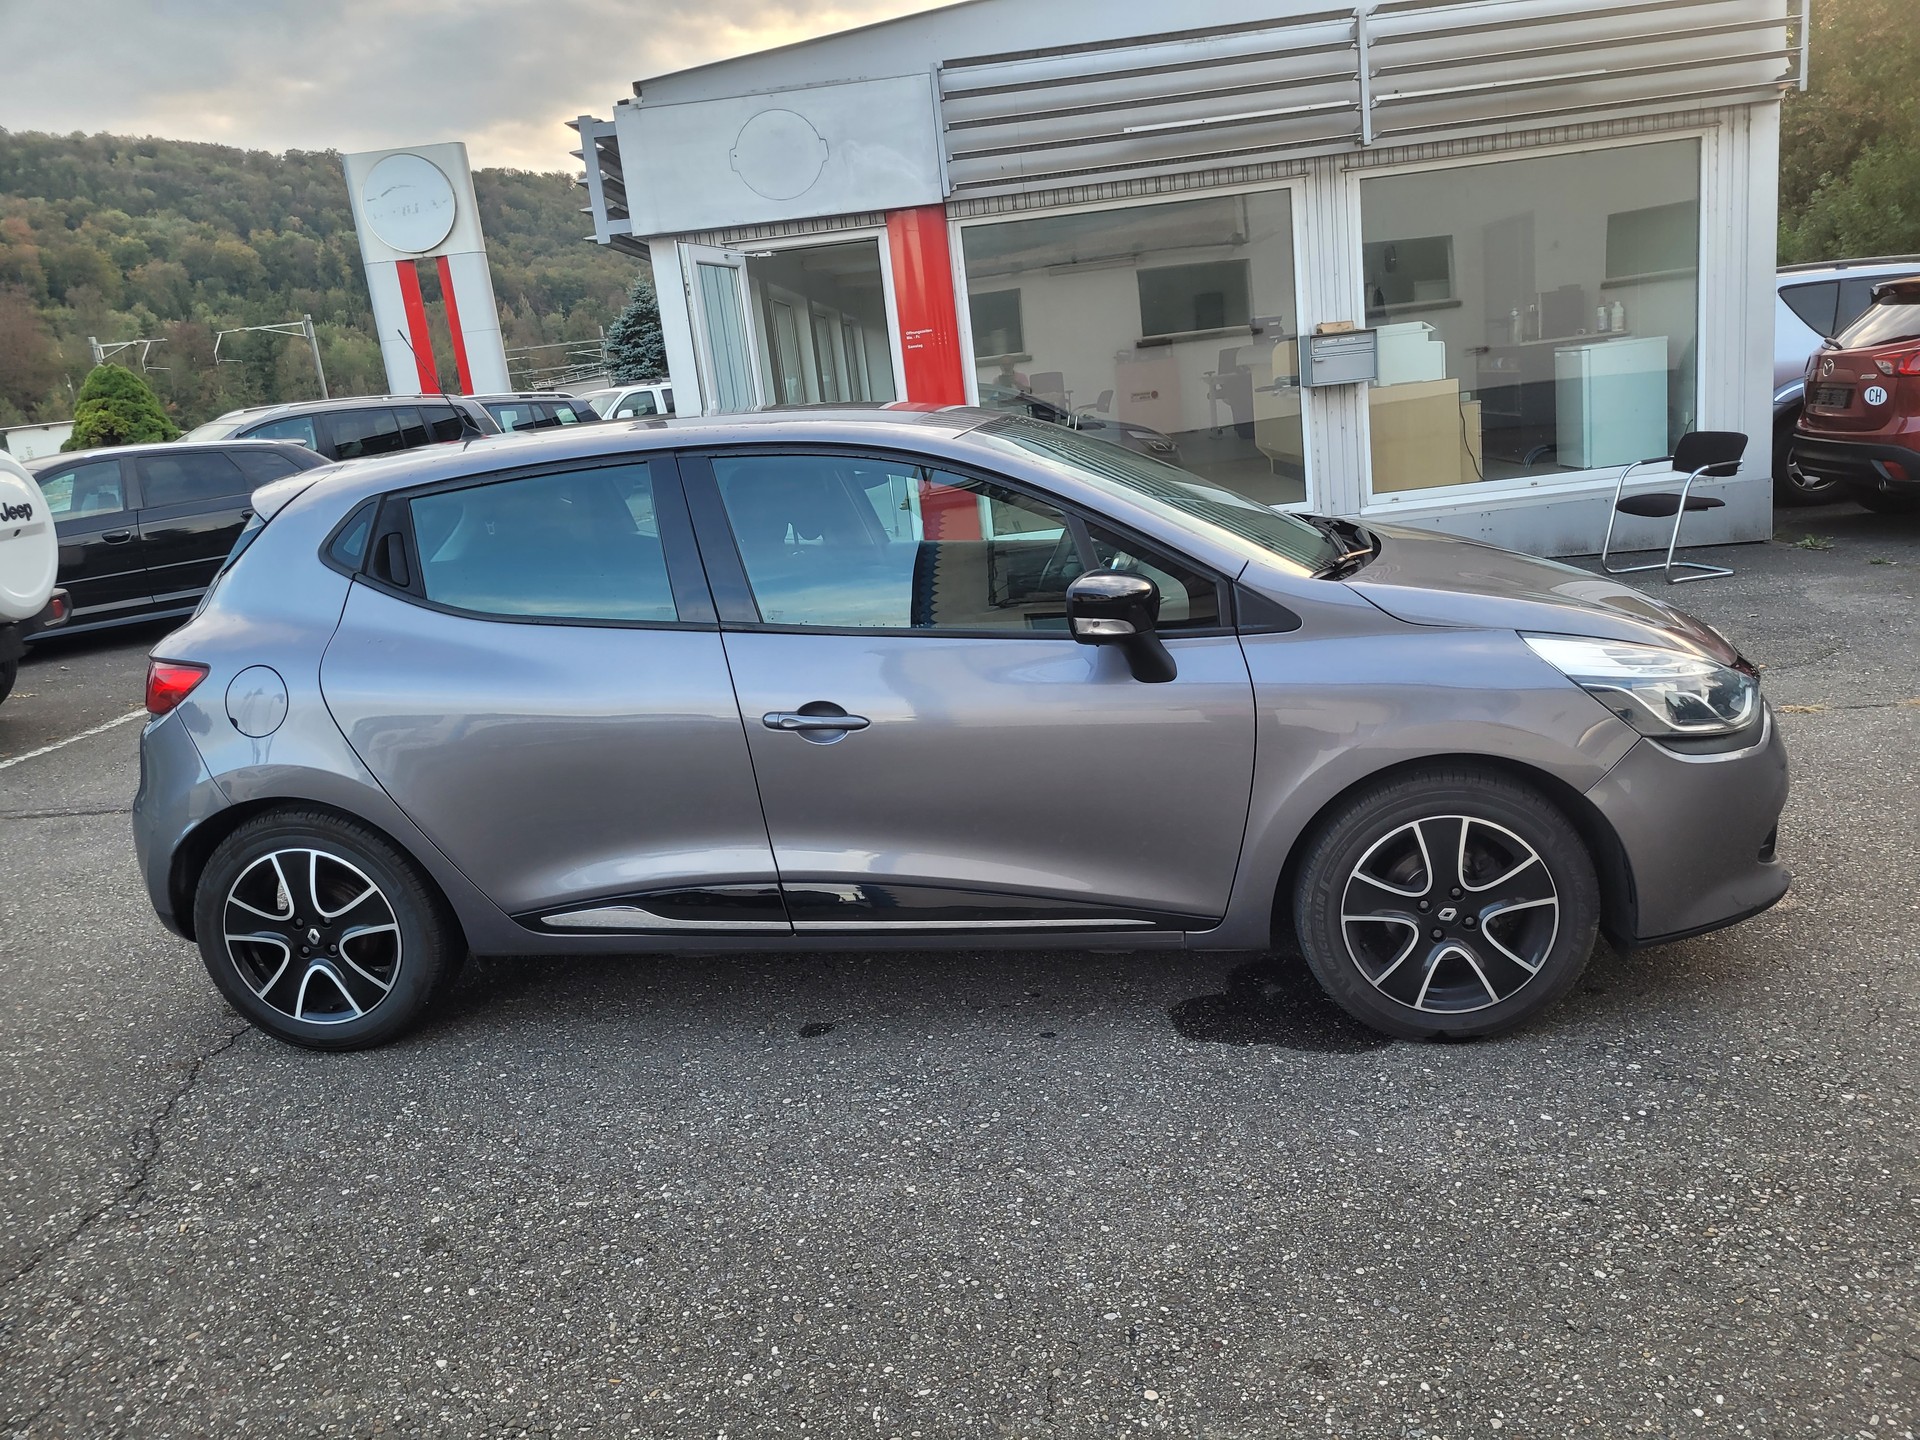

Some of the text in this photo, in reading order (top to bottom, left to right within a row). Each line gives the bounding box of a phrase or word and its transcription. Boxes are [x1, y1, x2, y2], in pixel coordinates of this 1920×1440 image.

[1869, 389, 1882, 402] CH
[0, 502, 33, 522] Jeep
[1315, 892, 1337, 970] MICHELIN
